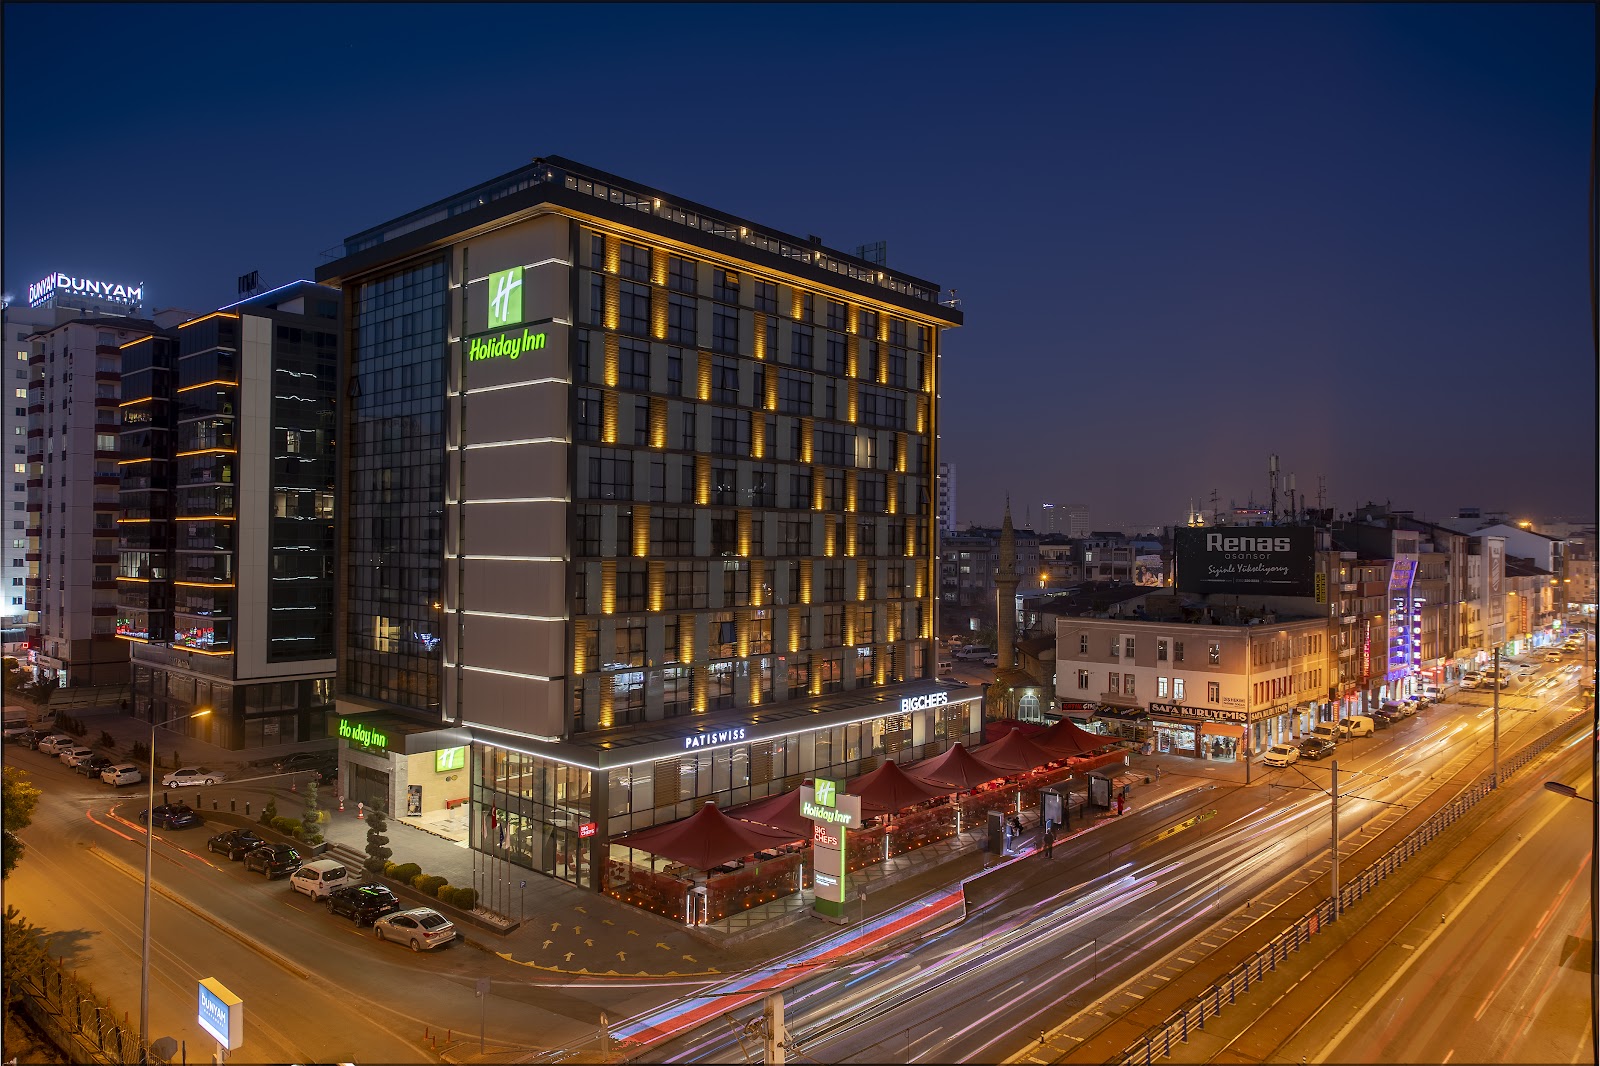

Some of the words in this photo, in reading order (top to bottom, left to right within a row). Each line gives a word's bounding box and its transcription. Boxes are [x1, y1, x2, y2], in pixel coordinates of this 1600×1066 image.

[469, 334, 521, 361] Holiday
[522, 328, 546, 352] Inn
[1206, 533, 1291, 552] Renas
[371, 727, 386, 748] Inn
[685, 728, 745, 749] PATISWISS
[803, 802, 834, 823] Holiday
[814, 825, 826, 836] BIG
[814, 834, 838, 846] CHEFS
